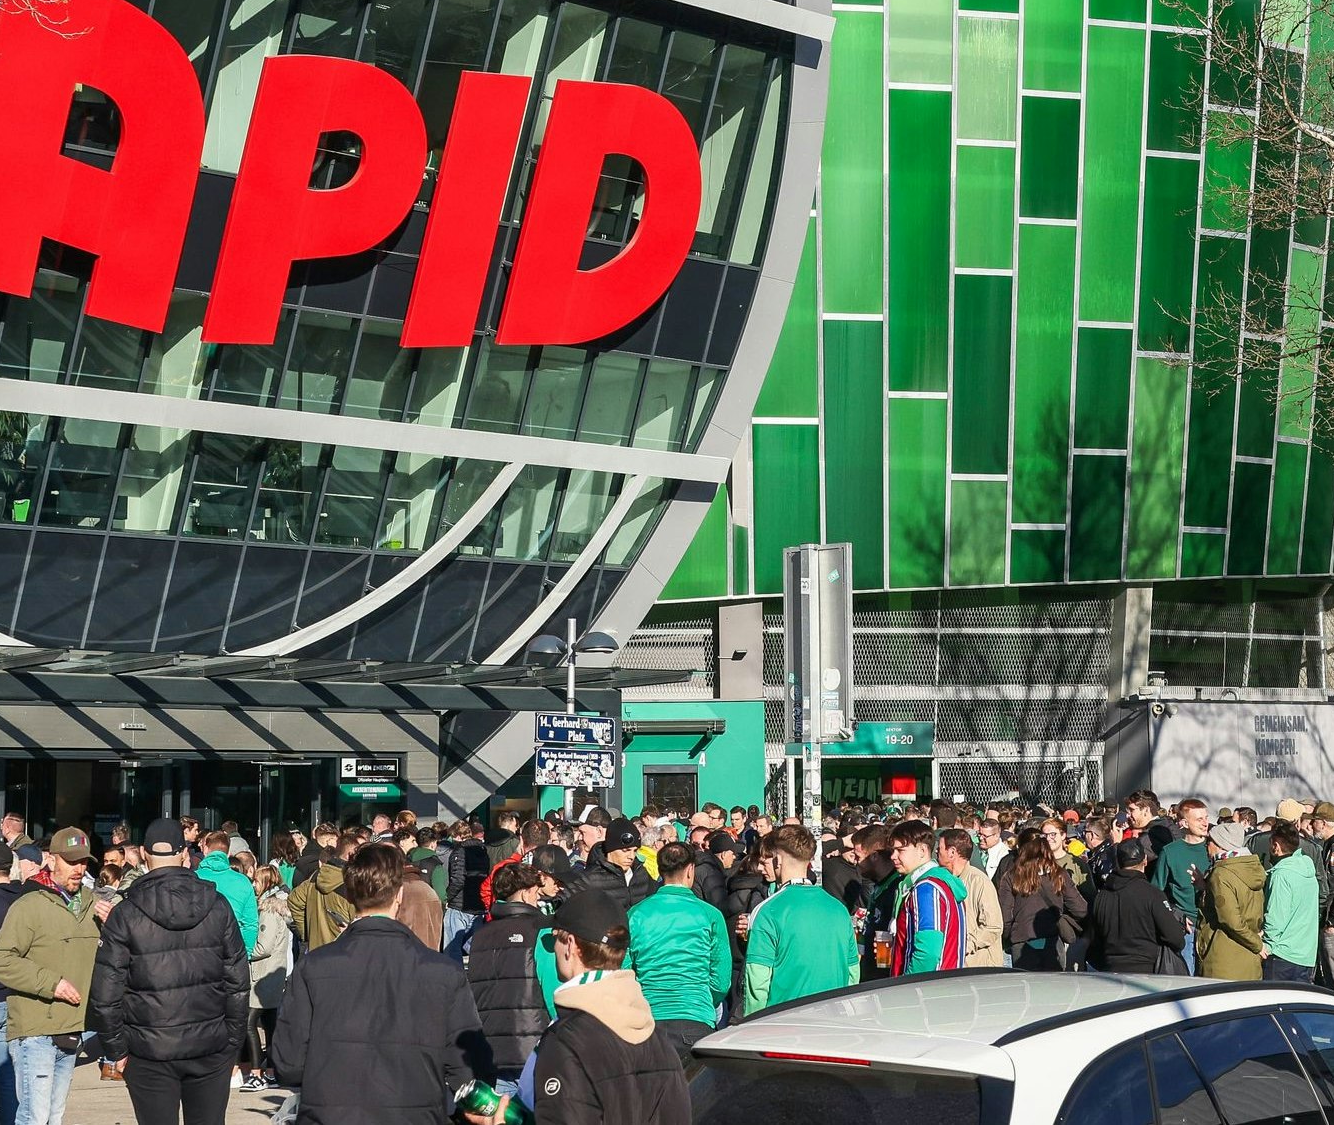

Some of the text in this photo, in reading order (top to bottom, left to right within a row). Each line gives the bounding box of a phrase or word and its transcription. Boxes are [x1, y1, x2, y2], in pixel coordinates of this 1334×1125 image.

[1254, 715, 1308, 733] GEMEINSAM.
[568, 730, 585, 742] Platz
[885, 735, 913, 745] 19-20
[1255, 734, 1298, 756] KÄMPFEN.
[699, 752, 706, 767] 4
